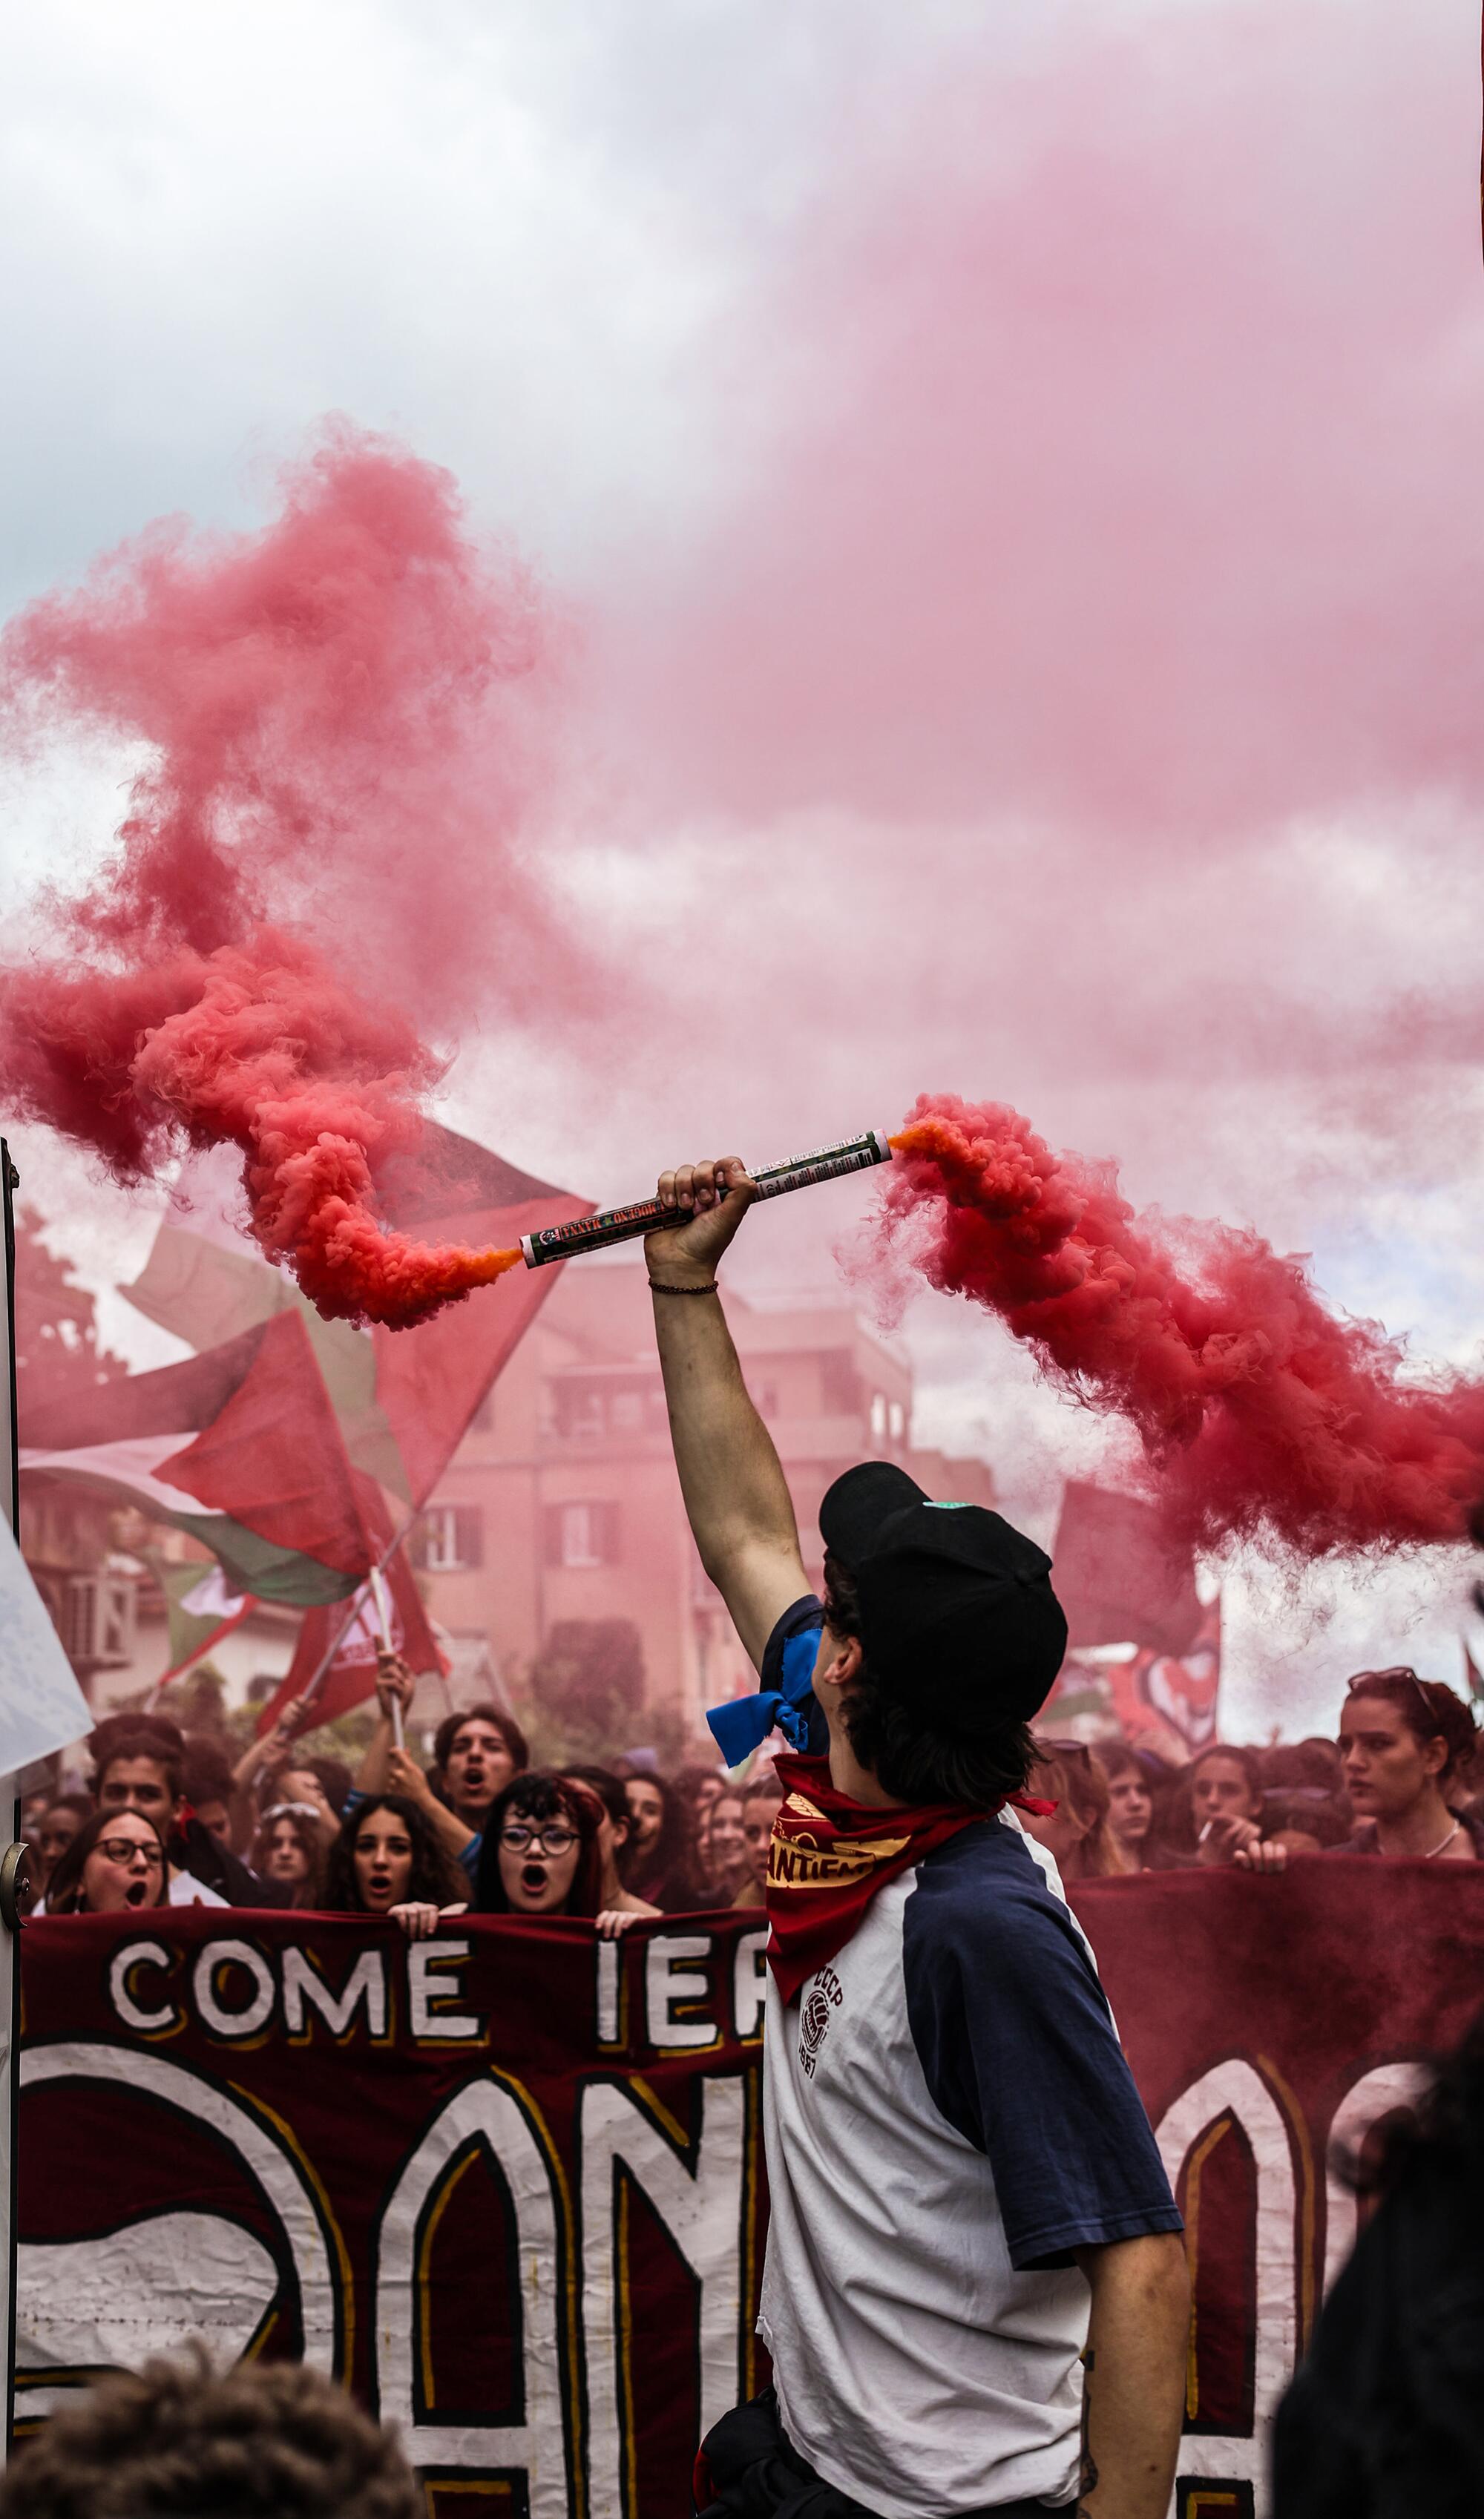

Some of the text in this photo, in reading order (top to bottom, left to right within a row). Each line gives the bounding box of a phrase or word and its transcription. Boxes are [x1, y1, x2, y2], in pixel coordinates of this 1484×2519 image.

[611, 1200, 665, 1224] UMOGENO
[109, 1938, 480, 2038] COME
[798, 2041, 816, 2079] 1987
